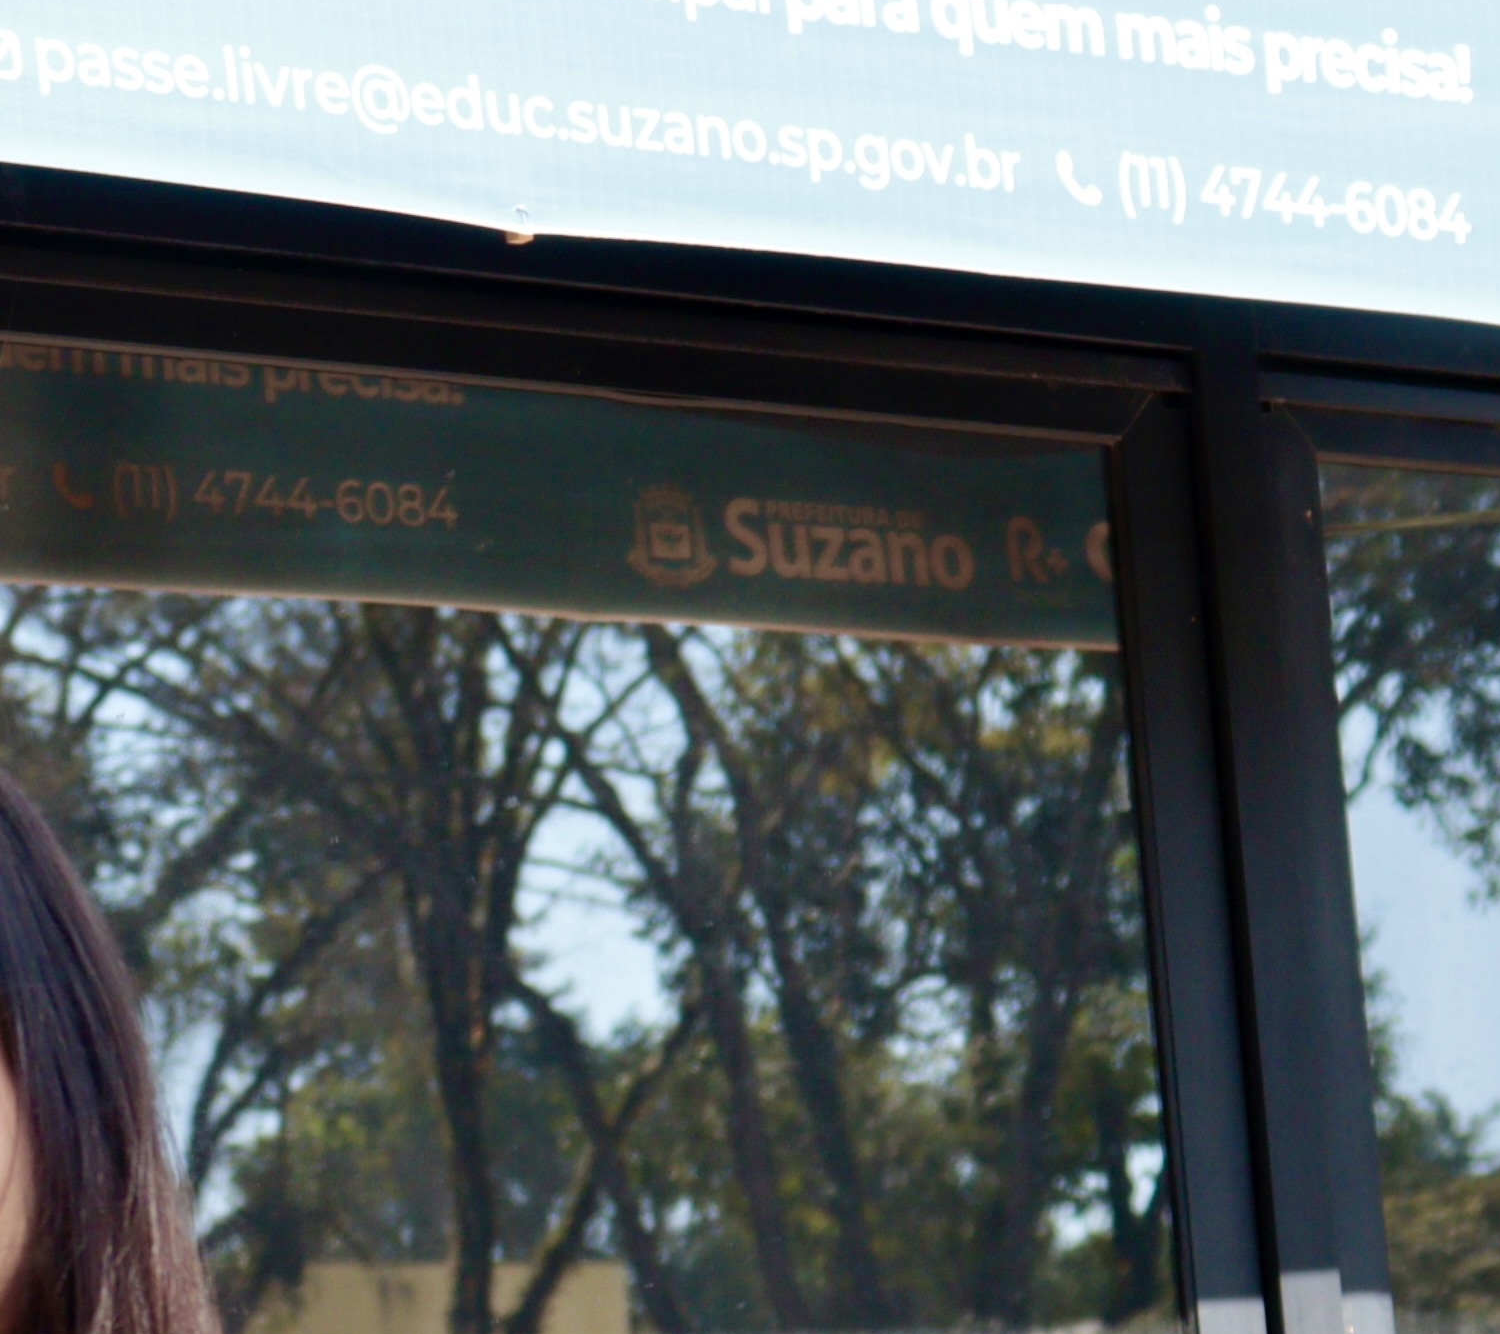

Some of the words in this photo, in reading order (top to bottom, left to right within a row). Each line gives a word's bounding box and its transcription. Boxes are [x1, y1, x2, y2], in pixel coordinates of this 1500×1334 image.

[1114, 4, 1255, 76] mais
[1263, 27, 1475, 105] precisa!
[34, 35, 1022, 191] passe.livre@educ.suzano.sp.gov.br
[1118, 151, 1188, 225] (11)
[1200, 163, 1472, 245] 4744-6084
[113, 459, 180, 521] (11)
[193, 471, 460, 530] 4744-6084
[724, 497, 974, 592] Suzano
